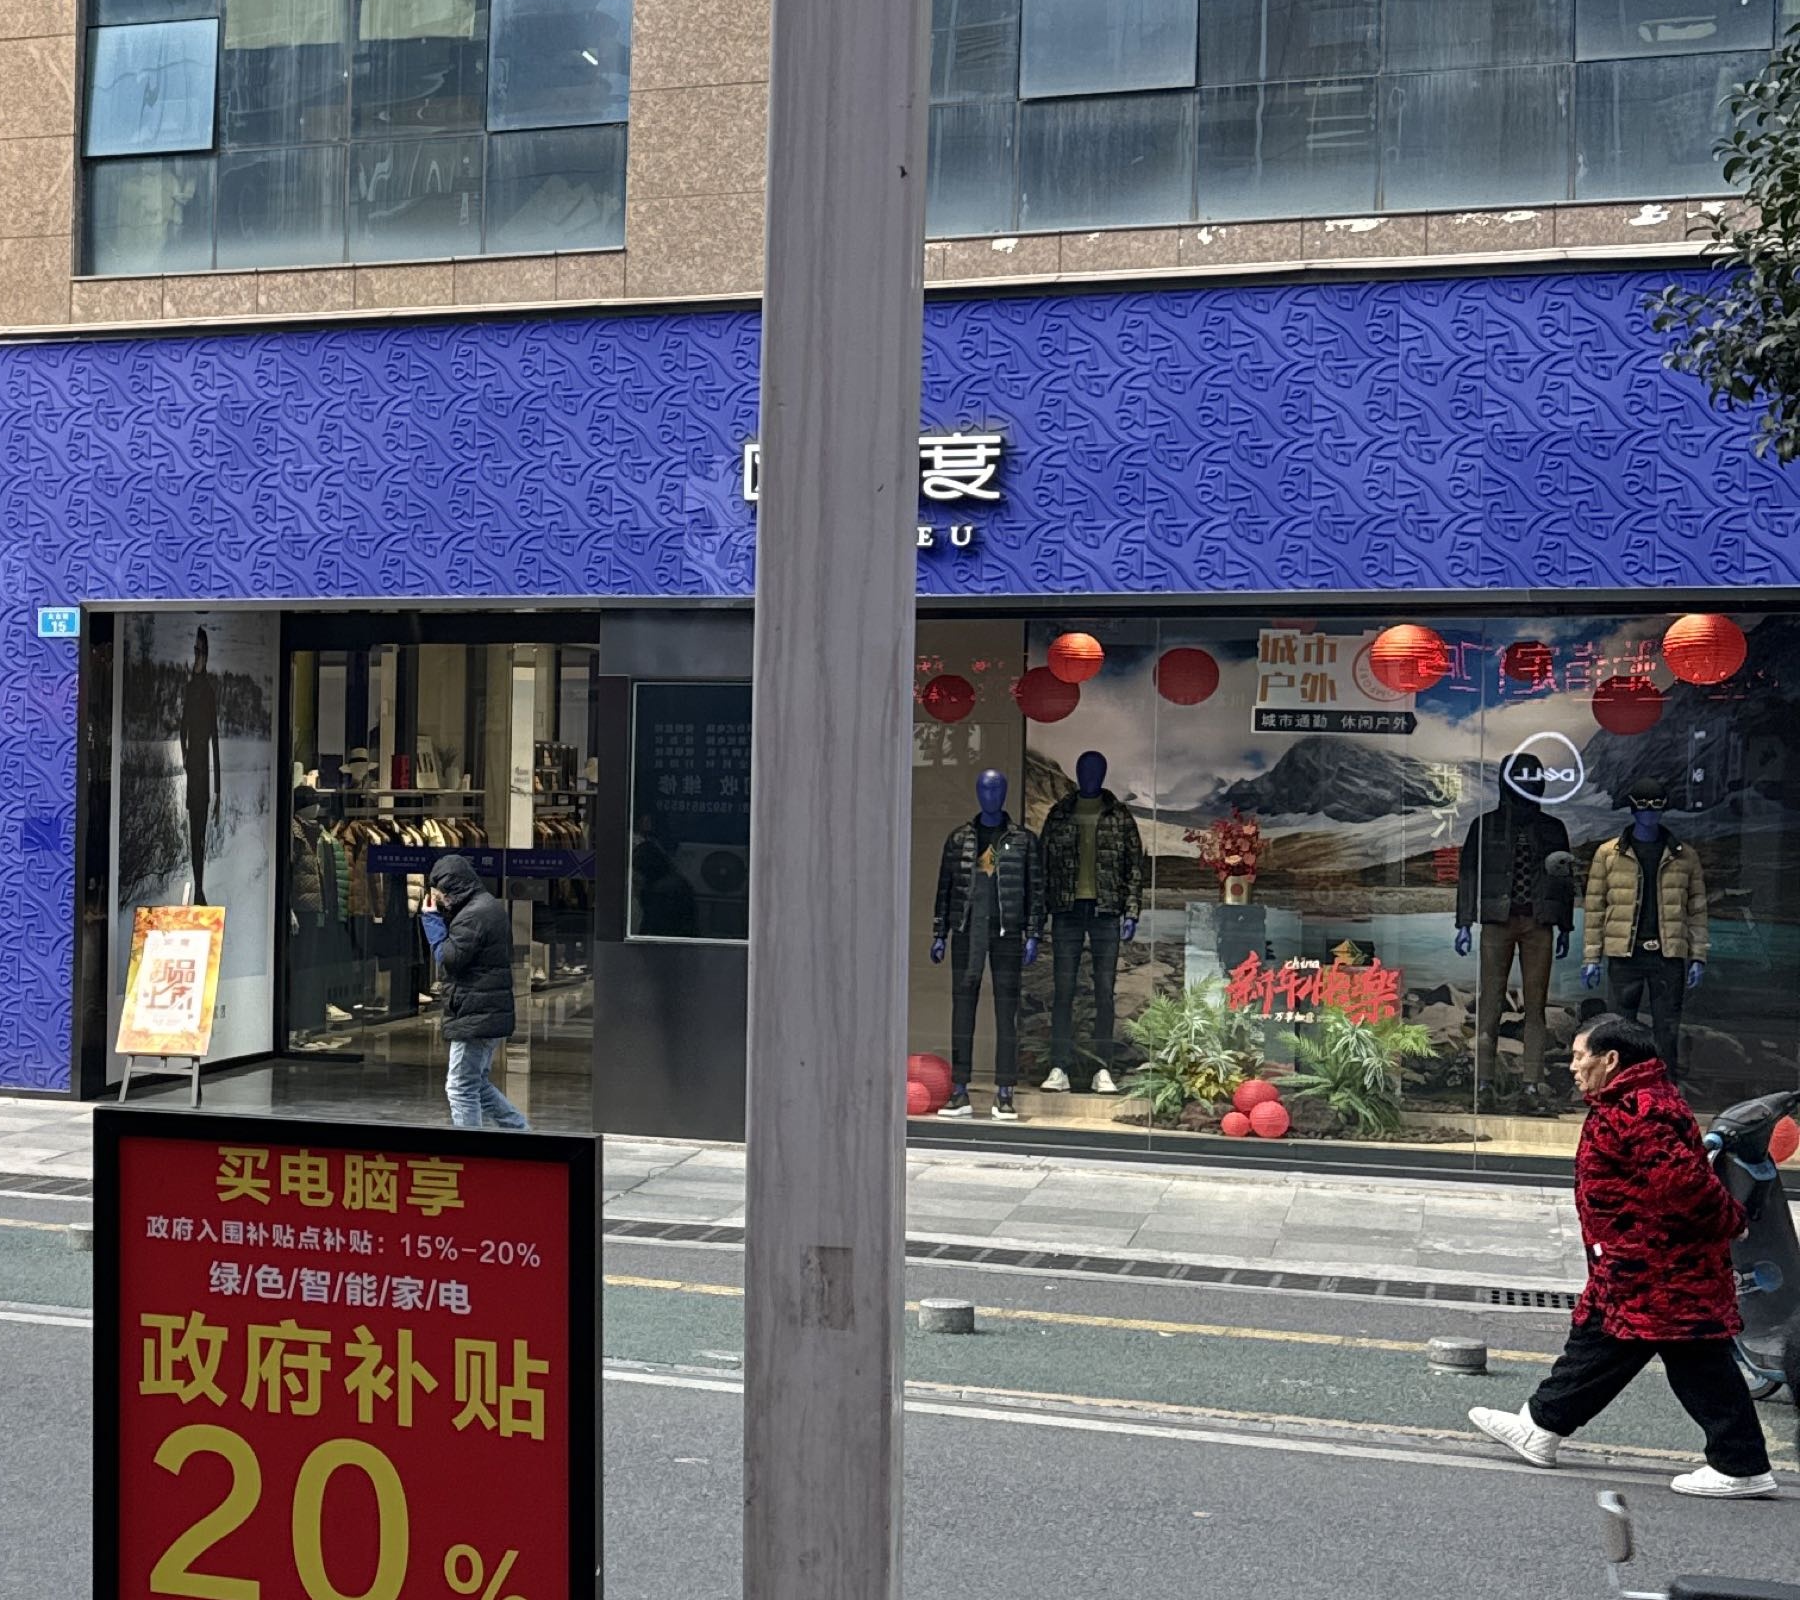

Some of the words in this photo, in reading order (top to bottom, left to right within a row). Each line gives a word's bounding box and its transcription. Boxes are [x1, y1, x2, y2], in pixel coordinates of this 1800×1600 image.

[51, 620, 67, 633] 15
[1260, 633, 1338, 665] 城市
[1258, 671, 1337, 704] 户外
[1260, 712, 1328, 729] 城市通勤
[1340, 714, 1409, 731] 休闲户外
[215, 1145, 466, 1217] 买电脑享
[208, 1261, 472, 1316] 绿/色/智/能/家/电
[138, 1311, 550, 1442] 政府补贴
